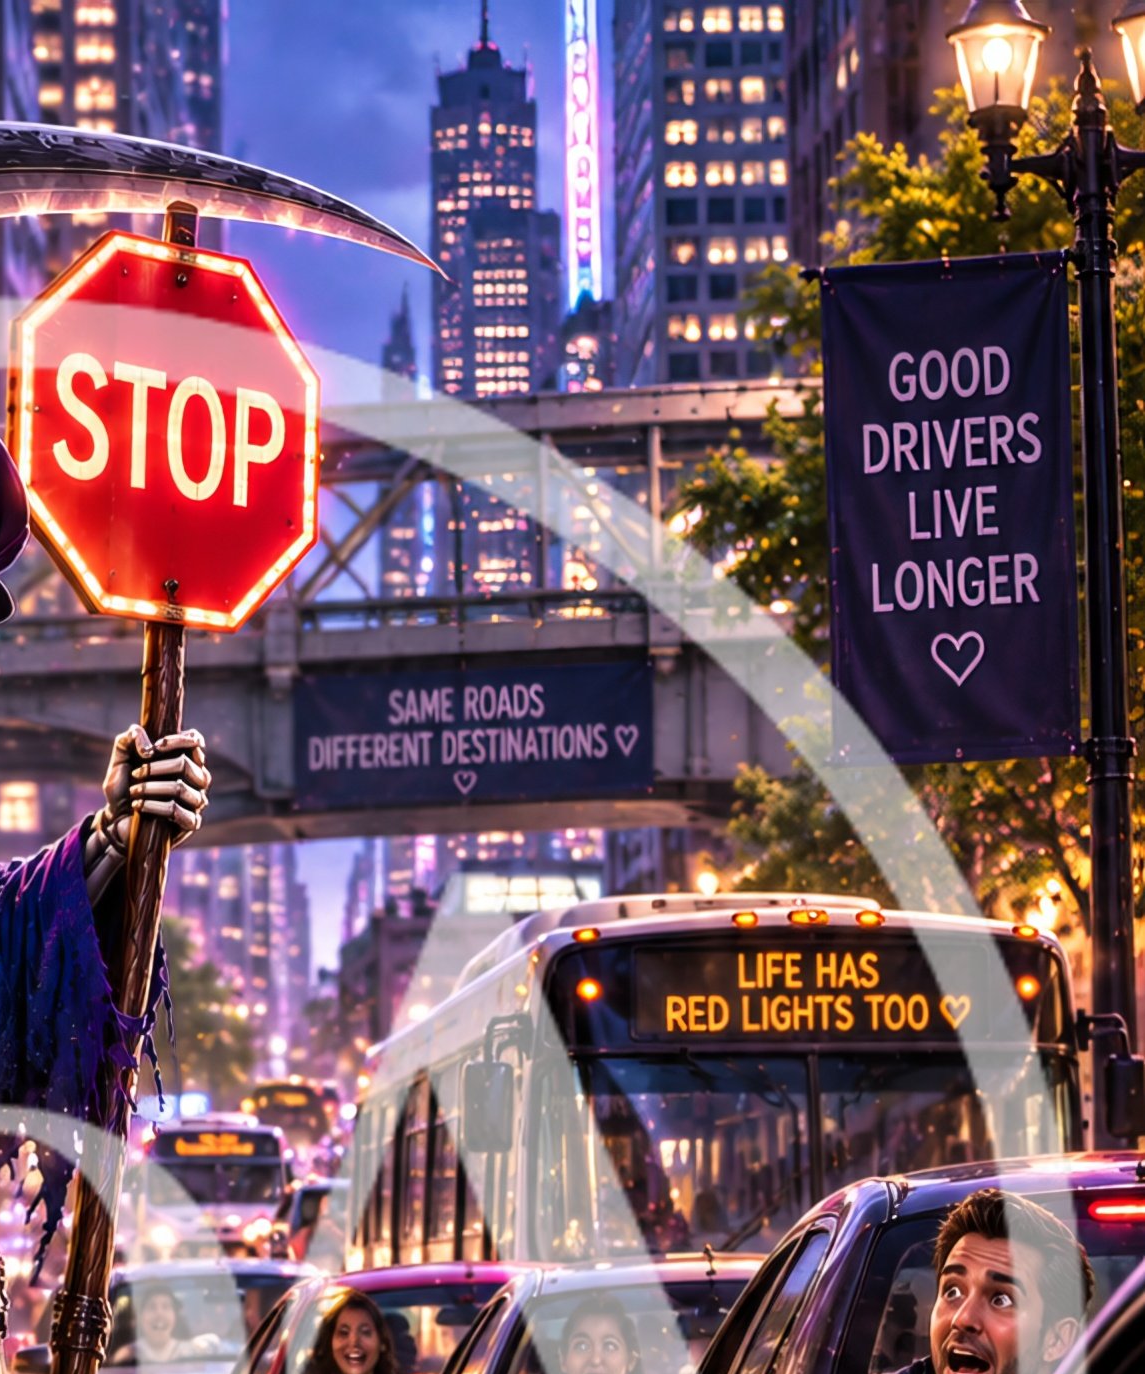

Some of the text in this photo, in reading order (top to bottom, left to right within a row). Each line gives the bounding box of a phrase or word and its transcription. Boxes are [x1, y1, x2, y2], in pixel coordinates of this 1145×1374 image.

[888, 346, 1010, 401] GOOD
[53, 352, 286, 507] STOP
[862, 412, 1042, 474] DRIVERS
[908, 485, 999, 540] LIVE
[871, 552, 1040, 612] LONGER
[388, 683, 545, 725] SAME ROADS
[307, 723, 608, 771] DIFFERENT DESTINATIONS
[738, 952, 879, 989] LIFE HAS
[666, 994, 929, 1032] RED LIGHTS TOO
